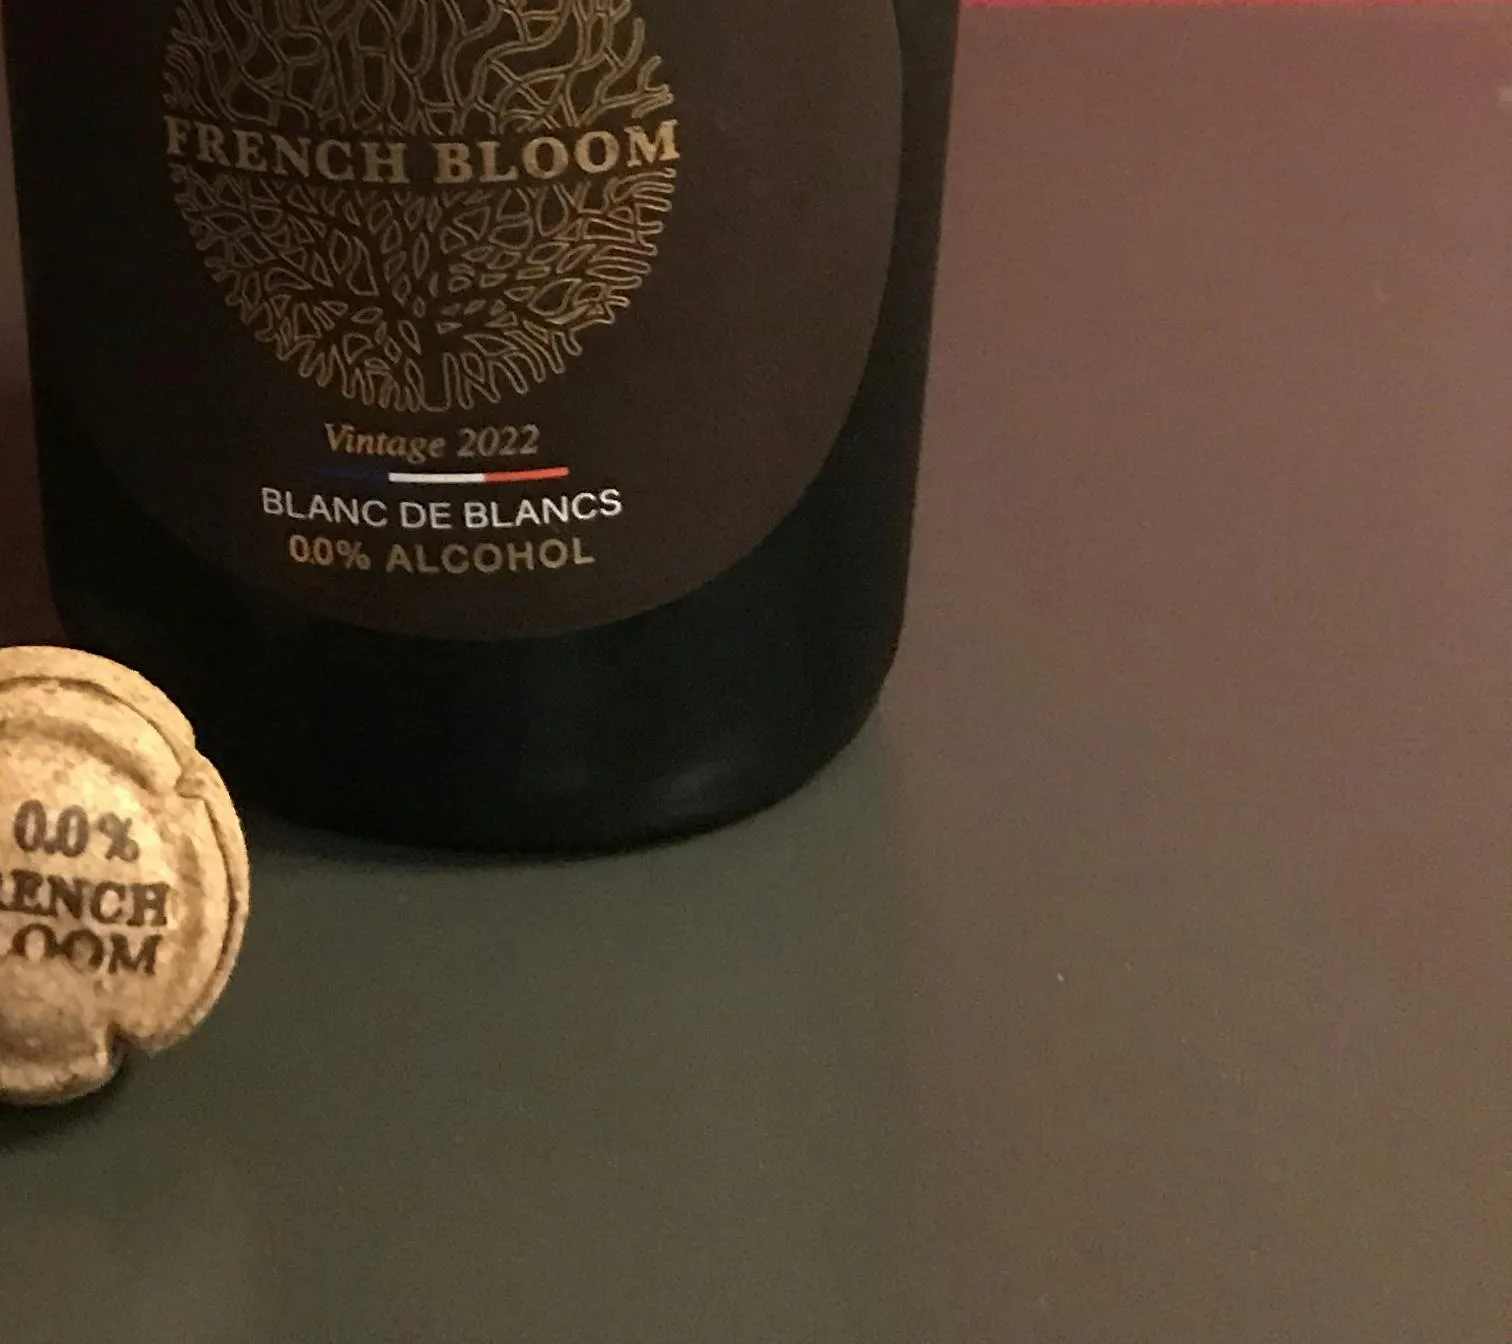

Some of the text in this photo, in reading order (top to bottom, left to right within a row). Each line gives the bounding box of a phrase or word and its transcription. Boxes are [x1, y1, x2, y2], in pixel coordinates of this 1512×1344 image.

[163, 114, 681, 185] FRENCH BLOOM
[323, 422, 541, 465] Vintage 2022
[260, 486, 624, 530] BLANC DE BLANCS
[288, 533, 596, 575] 0.0% ALCOHOL
[12, 799, 140, 862] 0.0%
